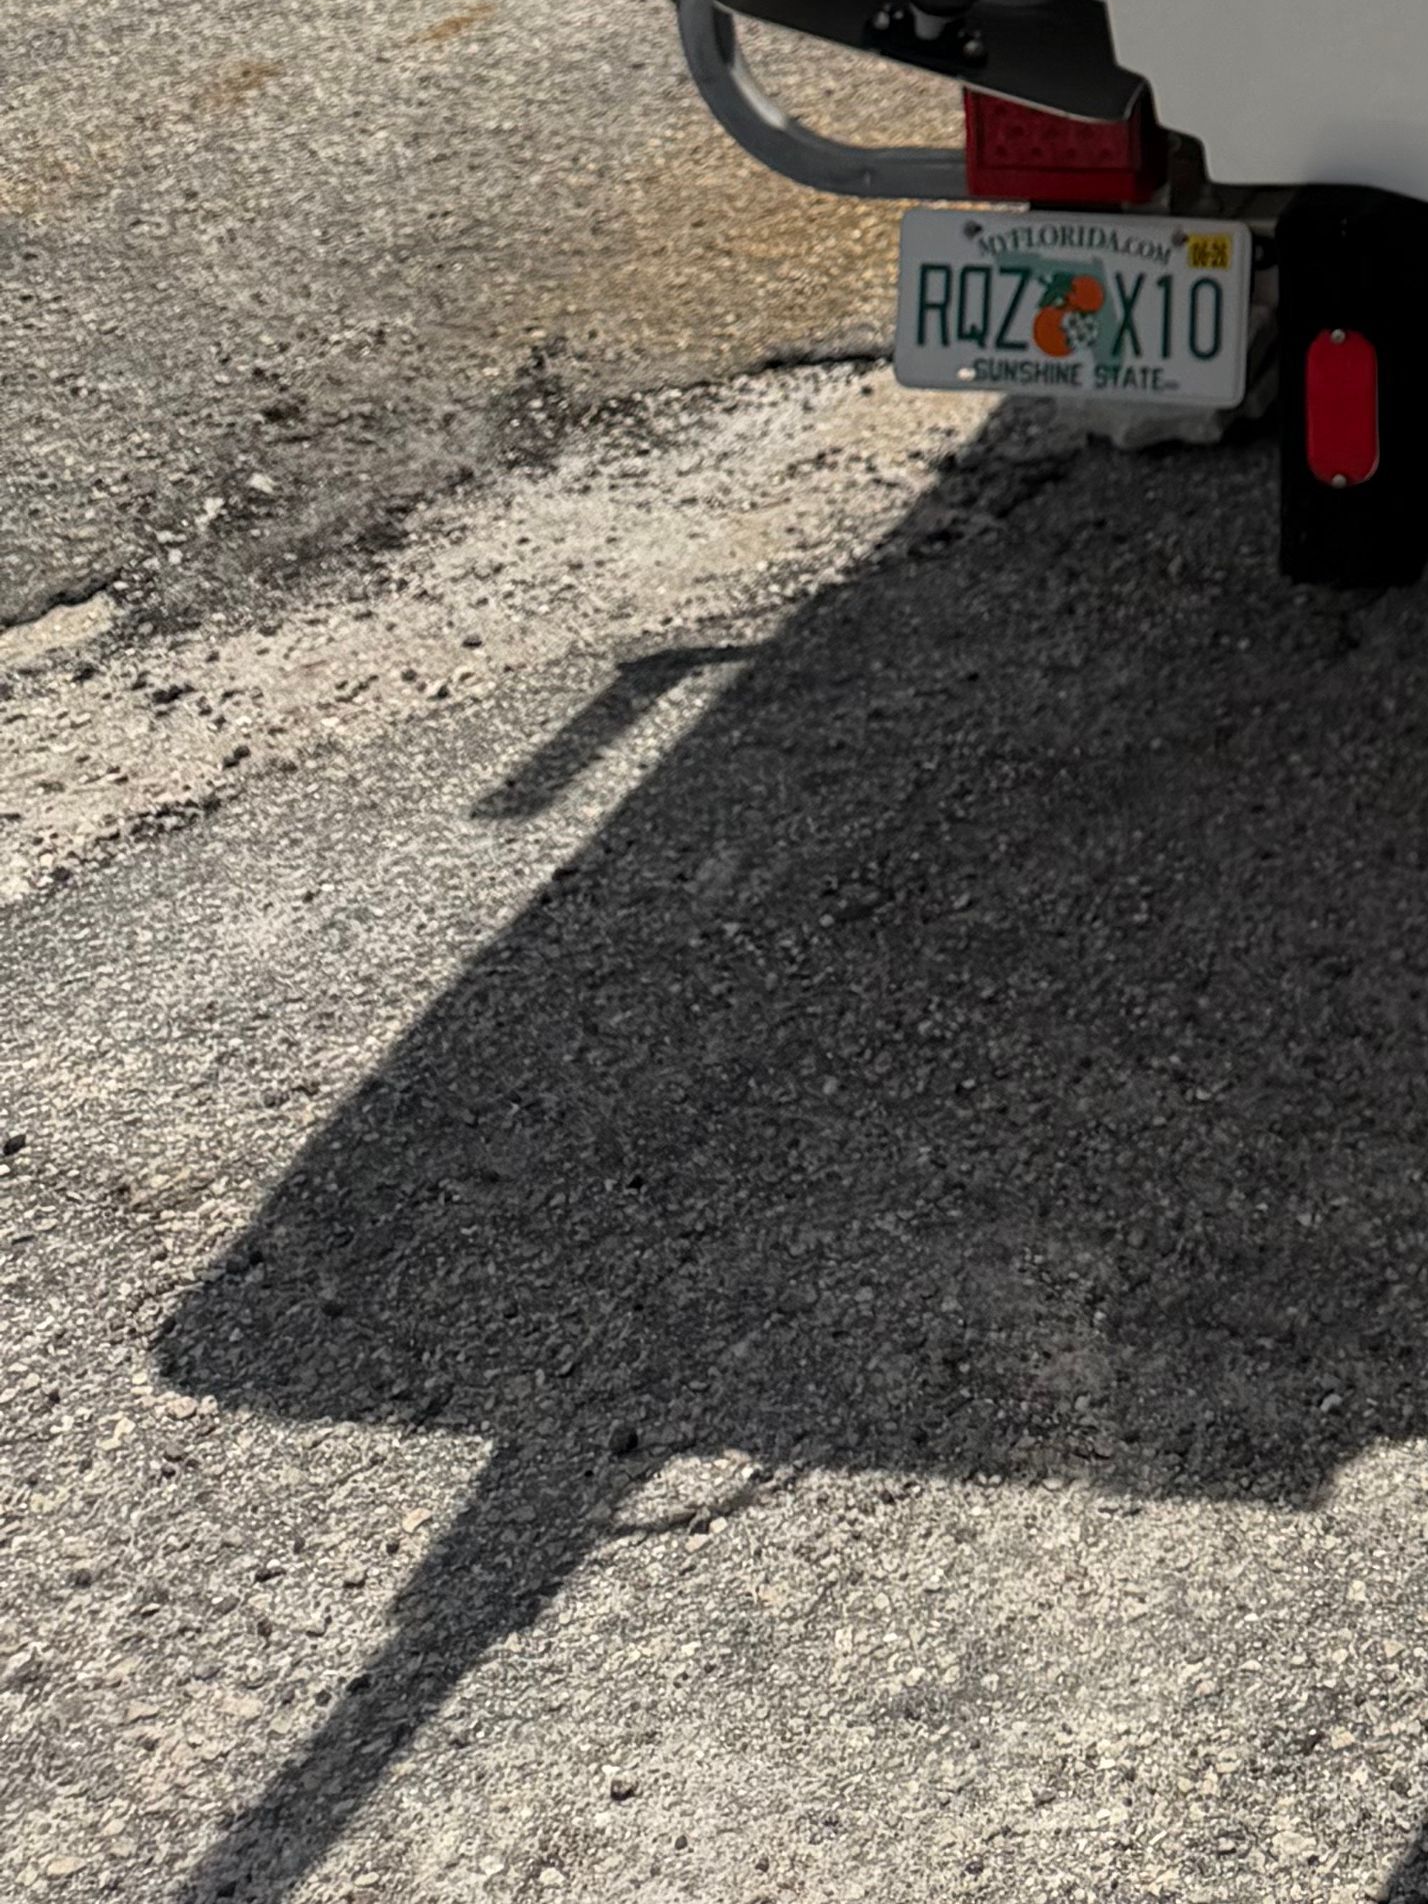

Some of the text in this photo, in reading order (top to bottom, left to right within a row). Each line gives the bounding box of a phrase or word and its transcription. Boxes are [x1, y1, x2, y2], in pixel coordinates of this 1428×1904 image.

[978, 223, 1172, 265] MYFLORIDA.COM
[917, 262, 1224, 361] RQZ X10
[973, 357, 1082, 385] SUNSHINE
[1094, 365, 1165, 391] STATE
